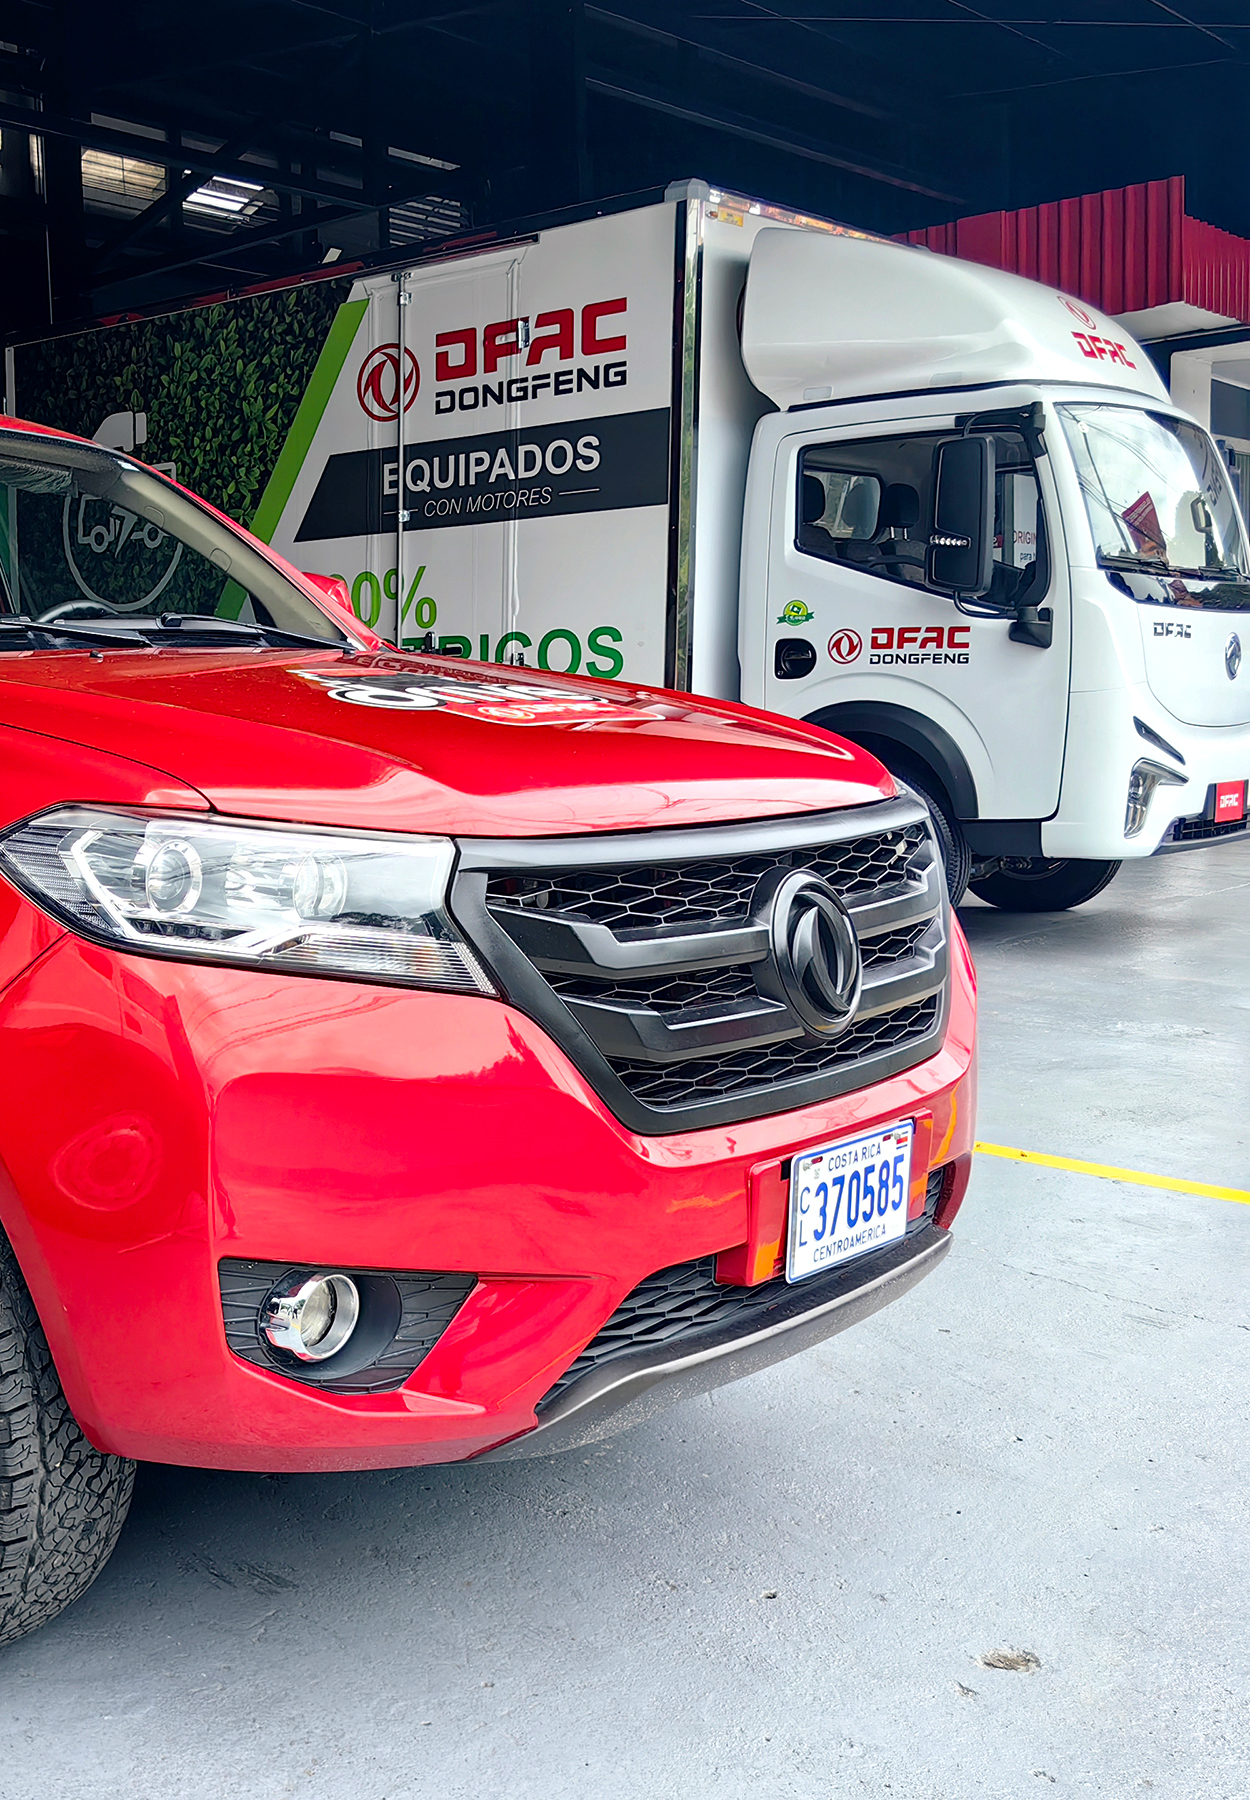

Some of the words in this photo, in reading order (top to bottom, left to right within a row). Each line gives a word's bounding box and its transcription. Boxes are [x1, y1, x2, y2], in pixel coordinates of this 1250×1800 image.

[435, 297, 627, 382] DFAC
[1070, 331, 1137, 370] DFAC
[435, 360, 627, 415] DONGFENG
[383, 435, 601, 495] EQUIPADOS
[424, 499, 462, 517] CON
[466, 486, 553, 513] MOTORES
[870, 626, 971, 650] DFAC
[1153, 621, 1192, 639] DFAC
[869, 653, 970, 665] DONGFENG
[1220, 793, 1239, 809] DFAC
[828, 1151, 859, 1172] COSTA
[860, 1142, 882, 1162] RICA
[813, 1153, 905, 1241] 370585
[813, 1223, 886, 1263] CENTROAMERICA
